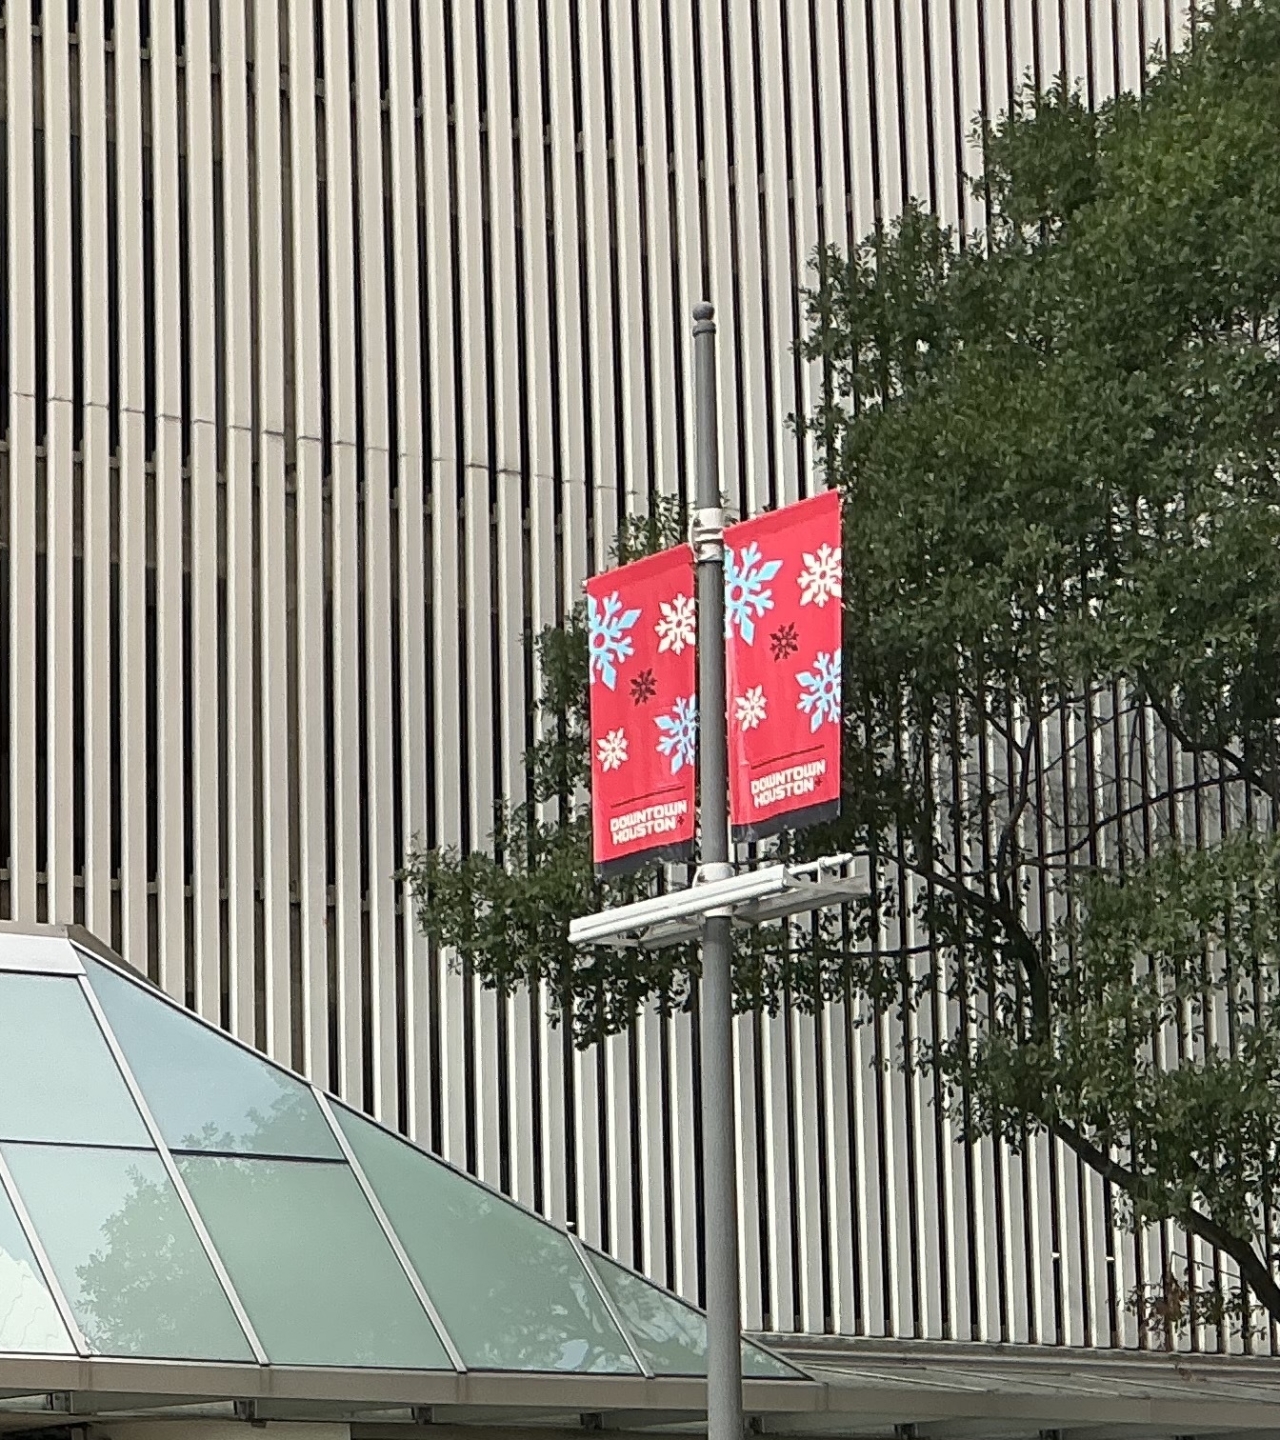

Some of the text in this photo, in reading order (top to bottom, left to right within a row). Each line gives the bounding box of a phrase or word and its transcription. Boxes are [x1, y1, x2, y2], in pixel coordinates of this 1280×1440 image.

[751, 758, 827, 795] DOWNTOWN
[753, 777, 815, 808] HOUSTON
[610, 800, 687, 832] DOWNTOWN
[612, 816, 677, 845] HOUSTON
